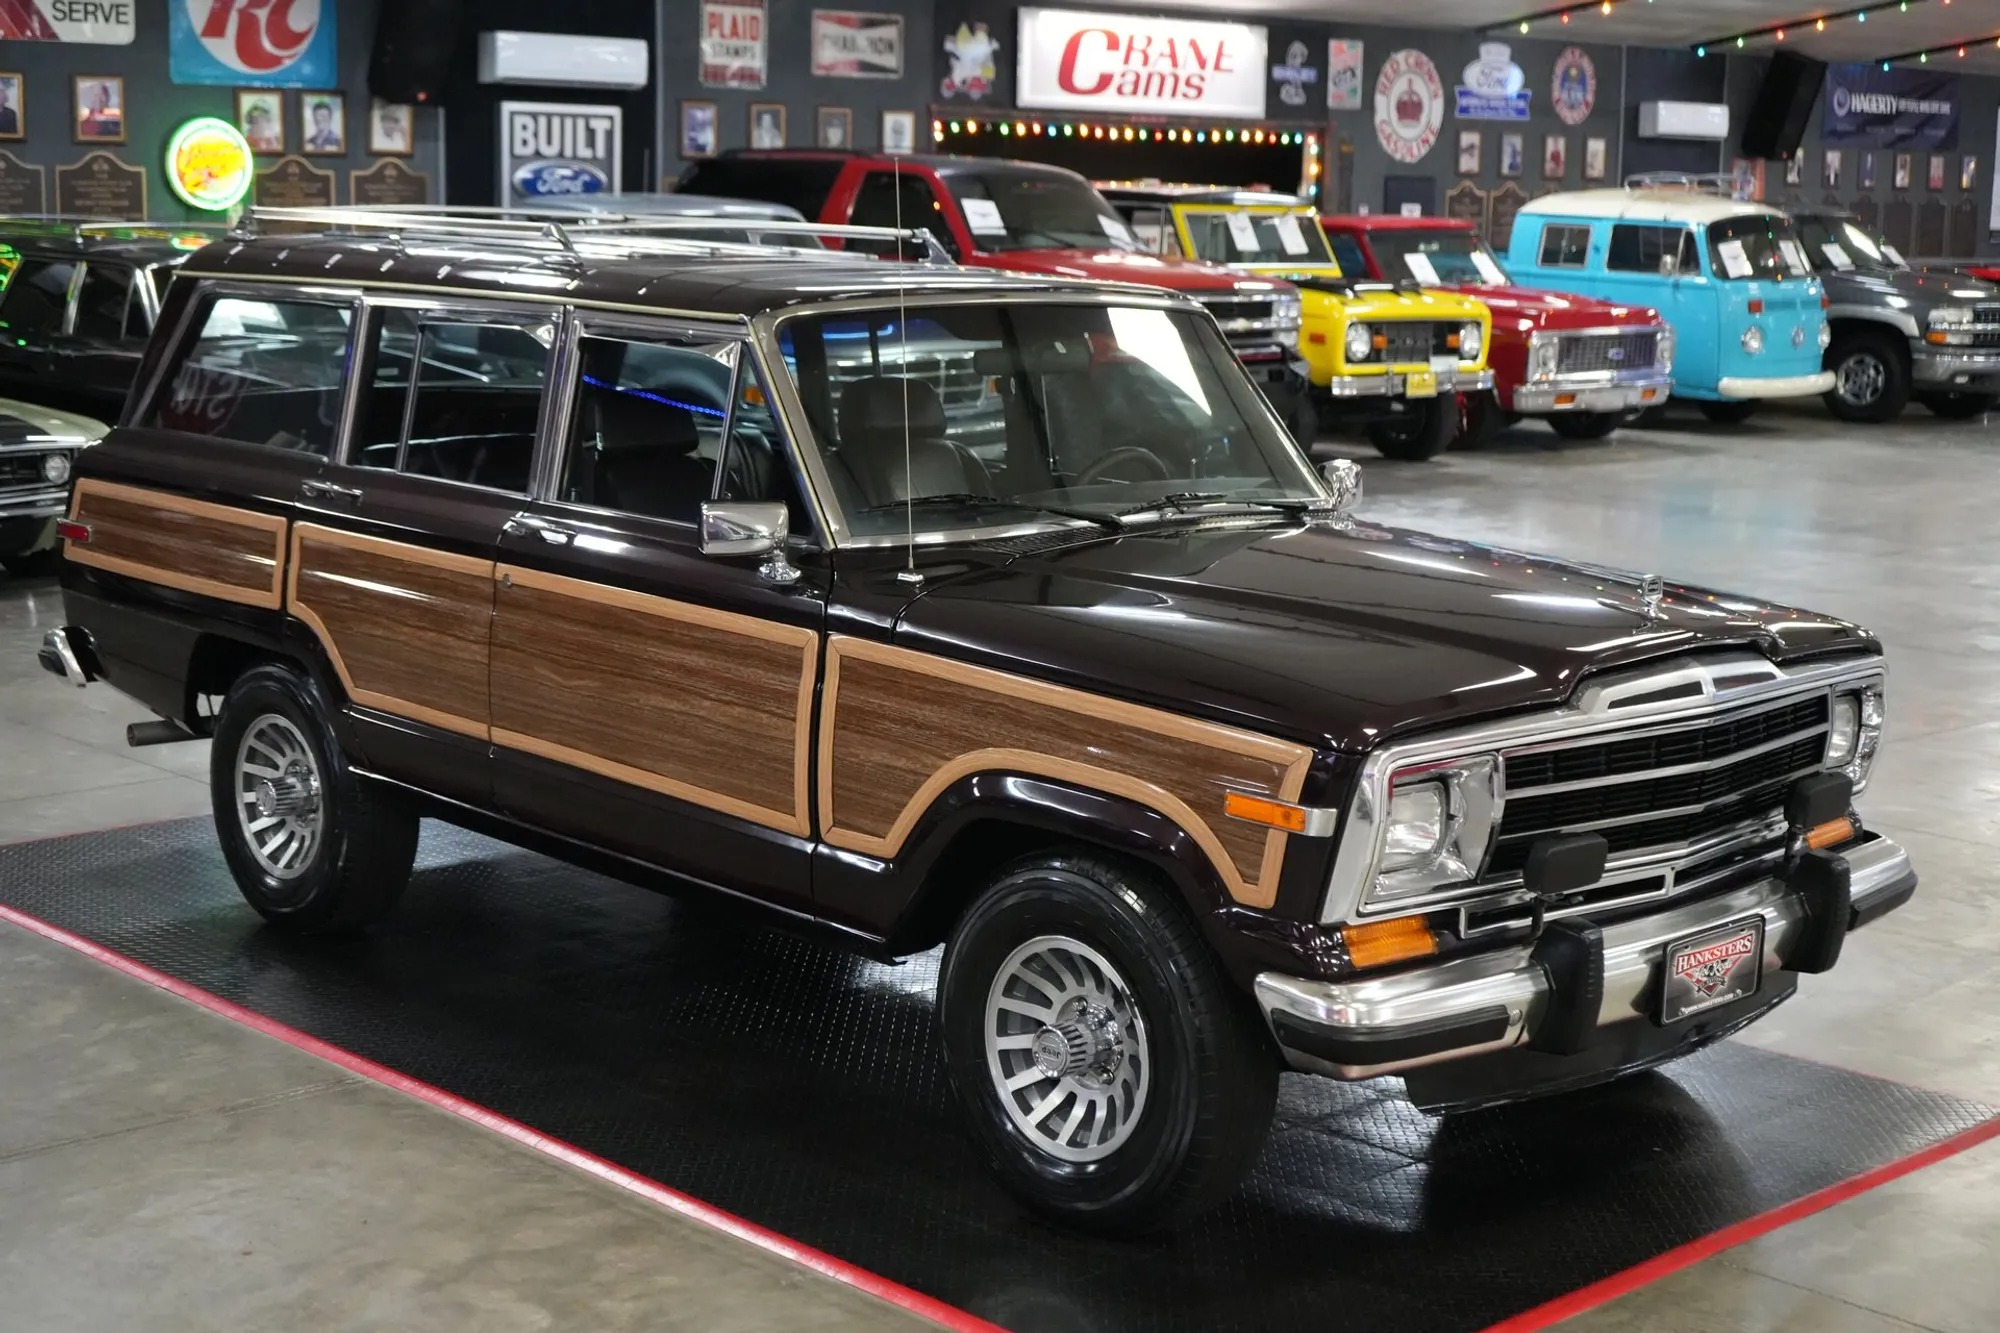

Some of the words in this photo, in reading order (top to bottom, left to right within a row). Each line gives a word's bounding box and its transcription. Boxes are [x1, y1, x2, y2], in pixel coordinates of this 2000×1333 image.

[52, 0, 130, 25] SERVE
[707, 11, 760, 42] PLAID
[201, 0, 314, 70] RC
[1851, 92, 1898, 115] HAGERTY
[512, 113, 612, 160] BUILT
[1677, 935, 1752, 972] HANKSTERS
